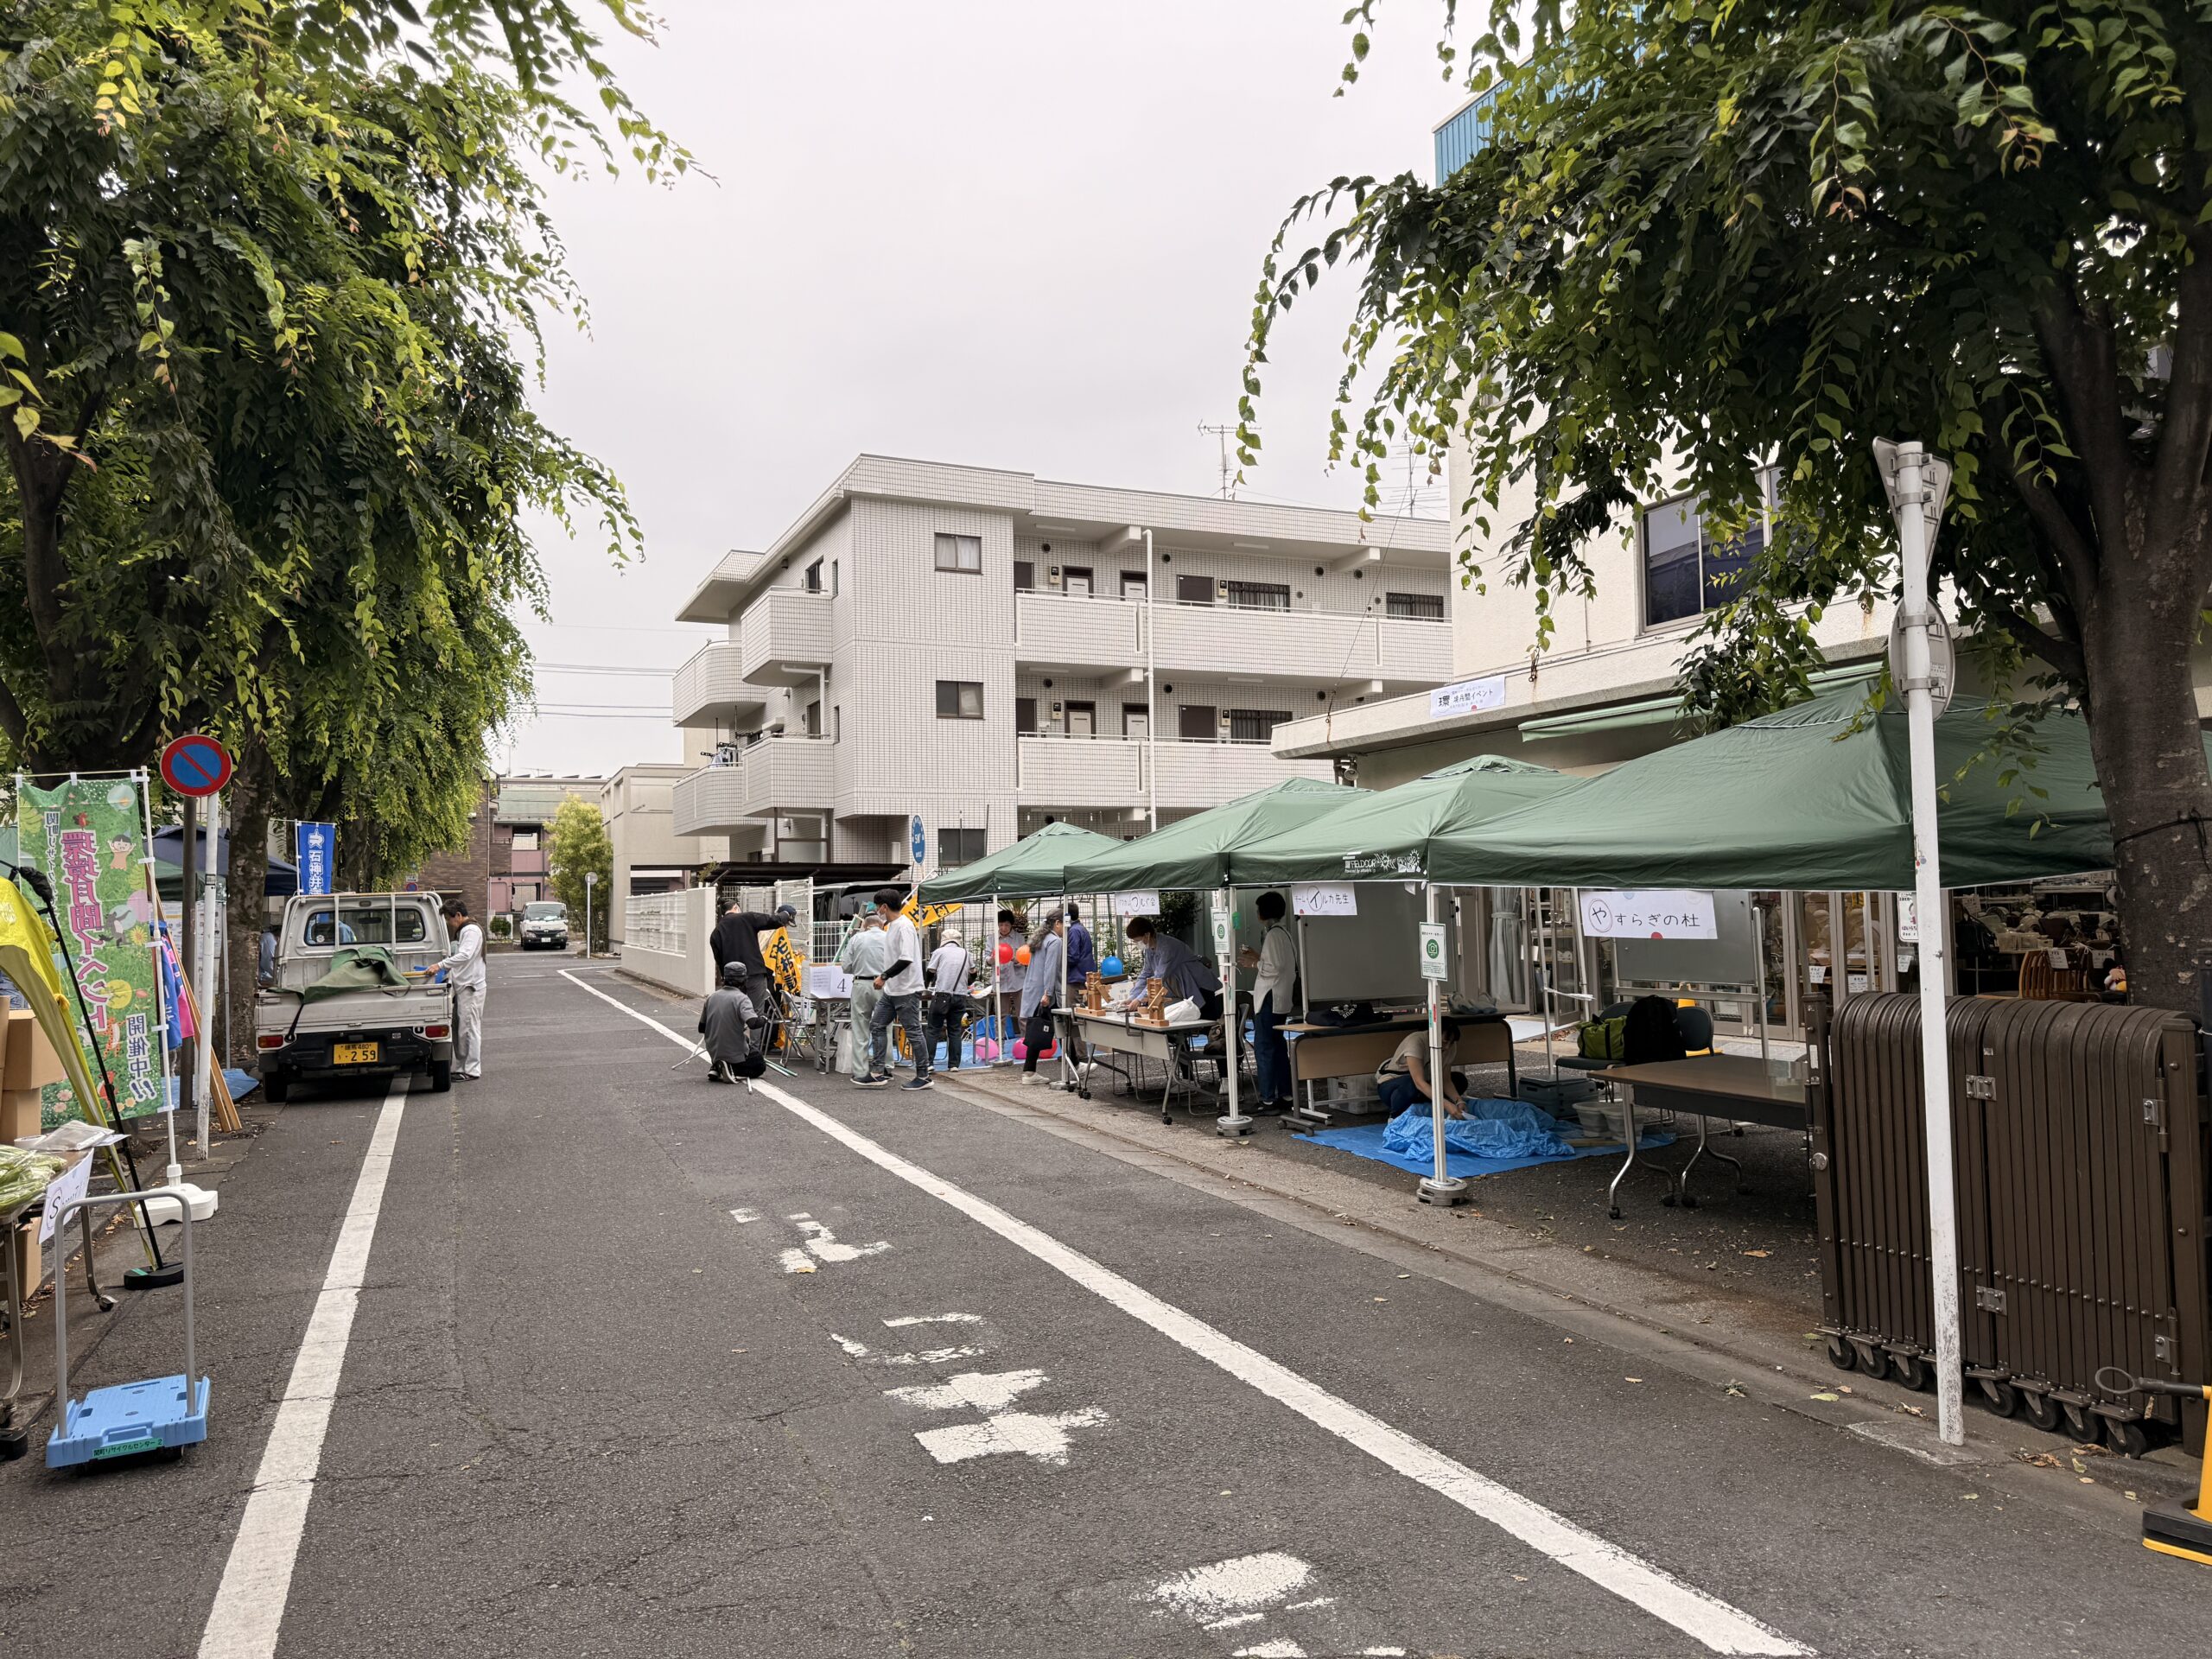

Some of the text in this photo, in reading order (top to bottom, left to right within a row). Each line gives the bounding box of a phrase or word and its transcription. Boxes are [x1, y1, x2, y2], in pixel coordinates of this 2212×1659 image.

[1592, 906, 1700, 927] やすらぎの杜
[837, 978, 847, 993] 4
